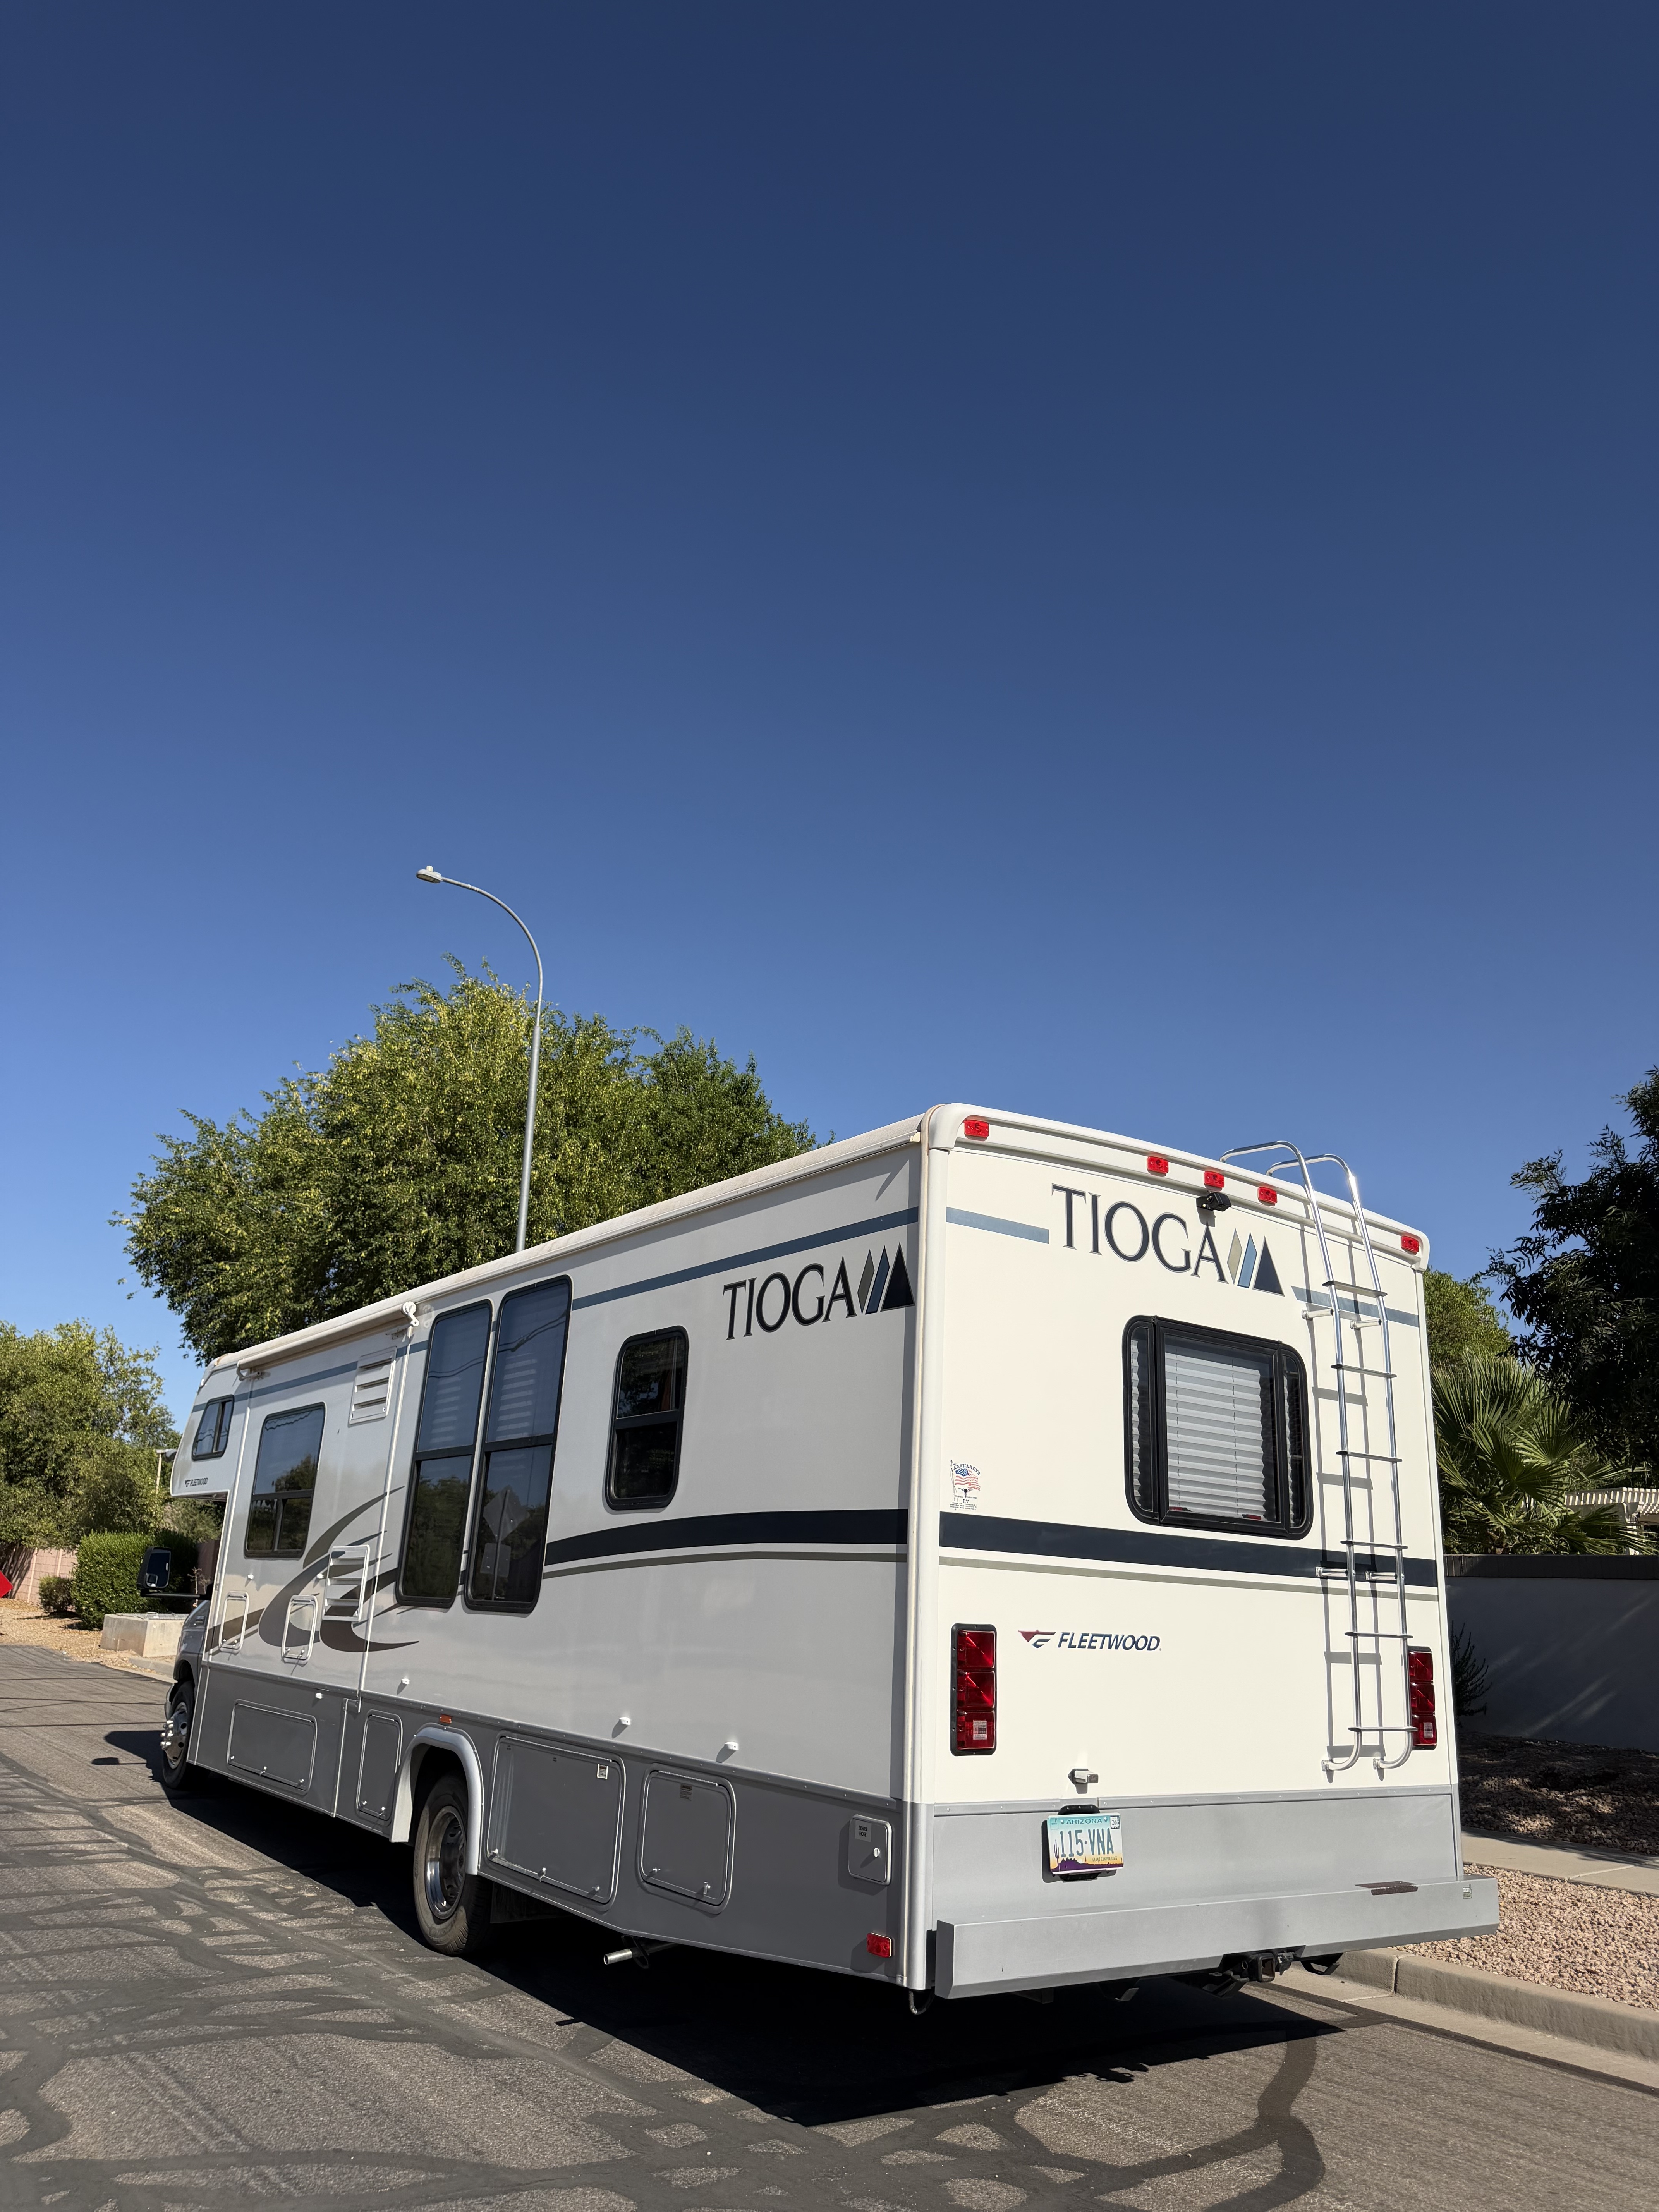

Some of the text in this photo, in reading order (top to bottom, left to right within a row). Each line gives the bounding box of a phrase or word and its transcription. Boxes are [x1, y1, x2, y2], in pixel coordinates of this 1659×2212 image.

[1051, 1183, 1229, 1284] TIOGA
[723, 1255, 857, 1340] TIOGA
[1058, 1632, 1160, 1651] FLEETWOOD
